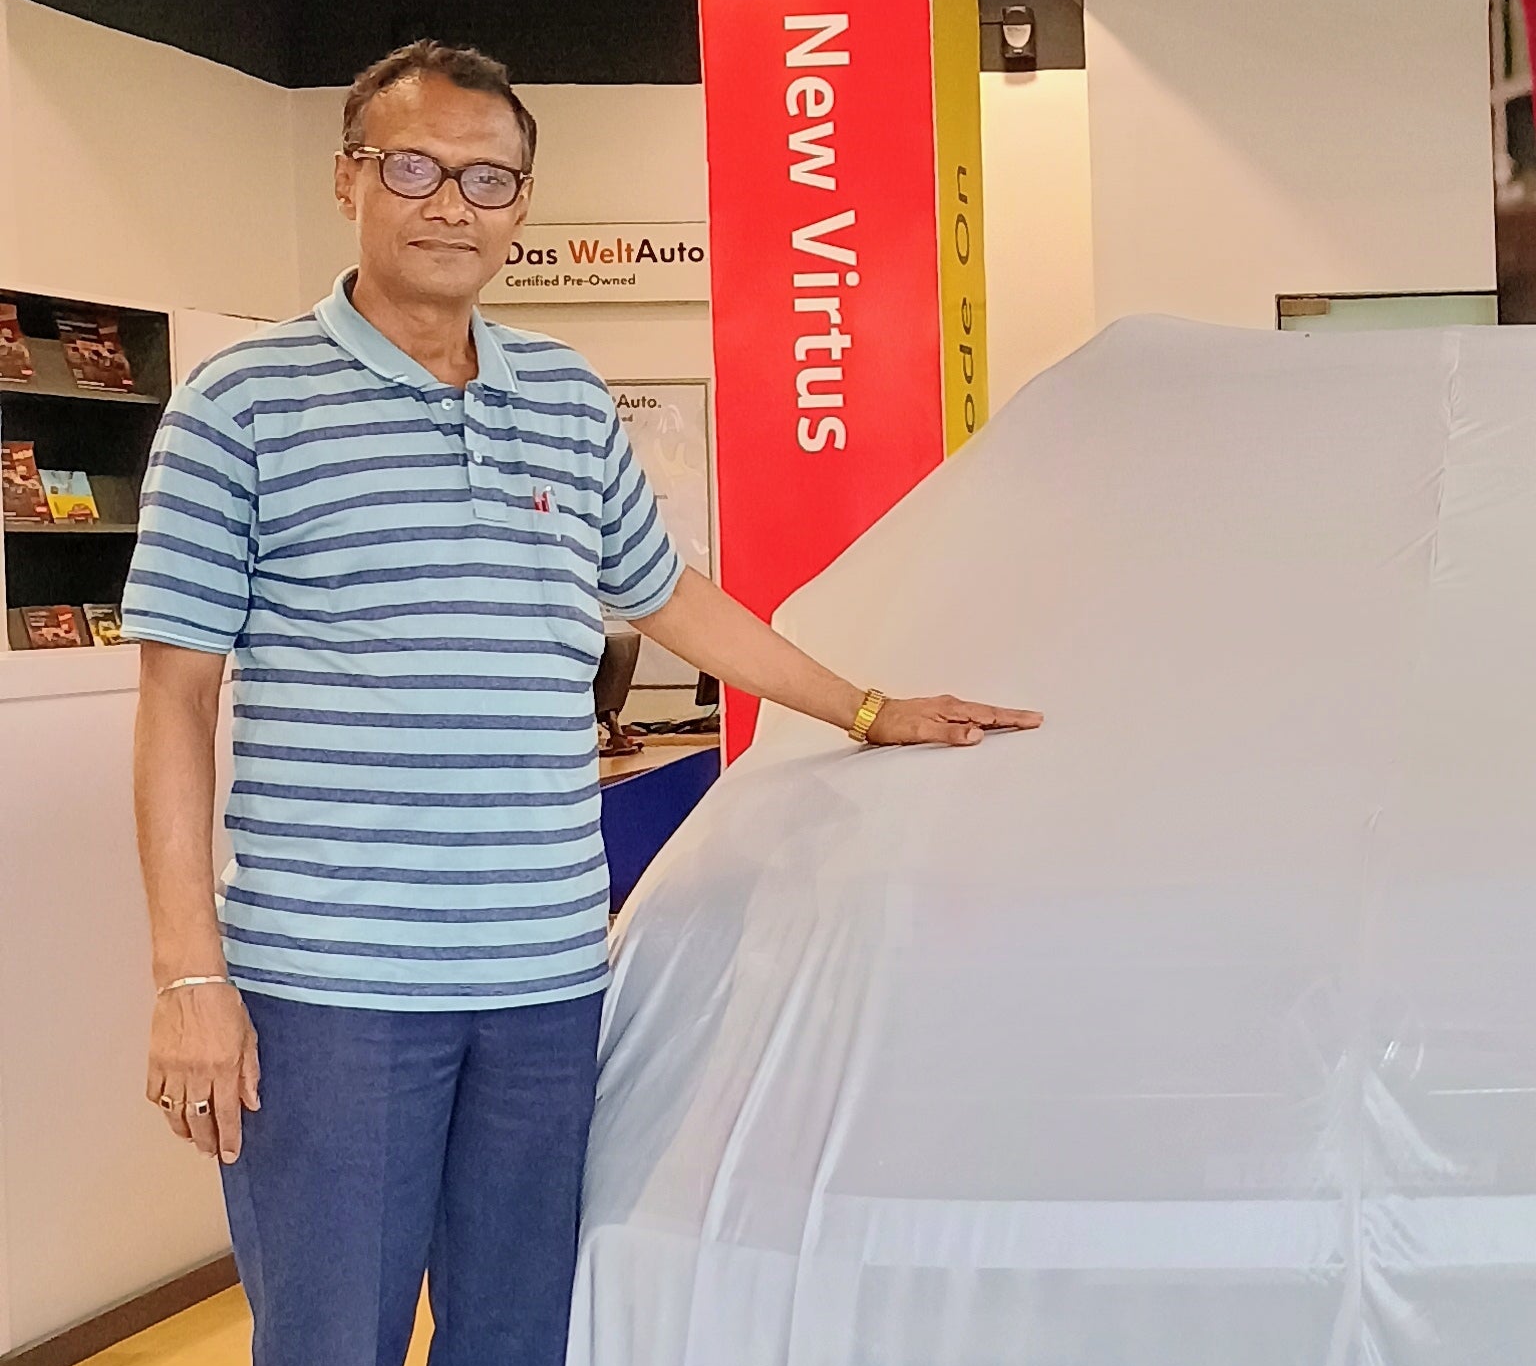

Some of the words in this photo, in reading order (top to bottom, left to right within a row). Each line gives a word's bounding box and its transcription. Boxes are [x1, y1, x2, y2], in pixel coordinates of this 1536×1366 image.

[783, 13, 851, 191] New
[505, 241, 559, 265] Das
[568, 238, 705, 264] WeltAuto
[954, 165, 971, 266] On
[505, 275, 560, 287] Certified
[563, 273, 636, 286] Pre-Owned
[791, 209, 861, 453] Virtus
[958, 296, 977, 434] ode
[613, 393, 662, 409] Auto.
